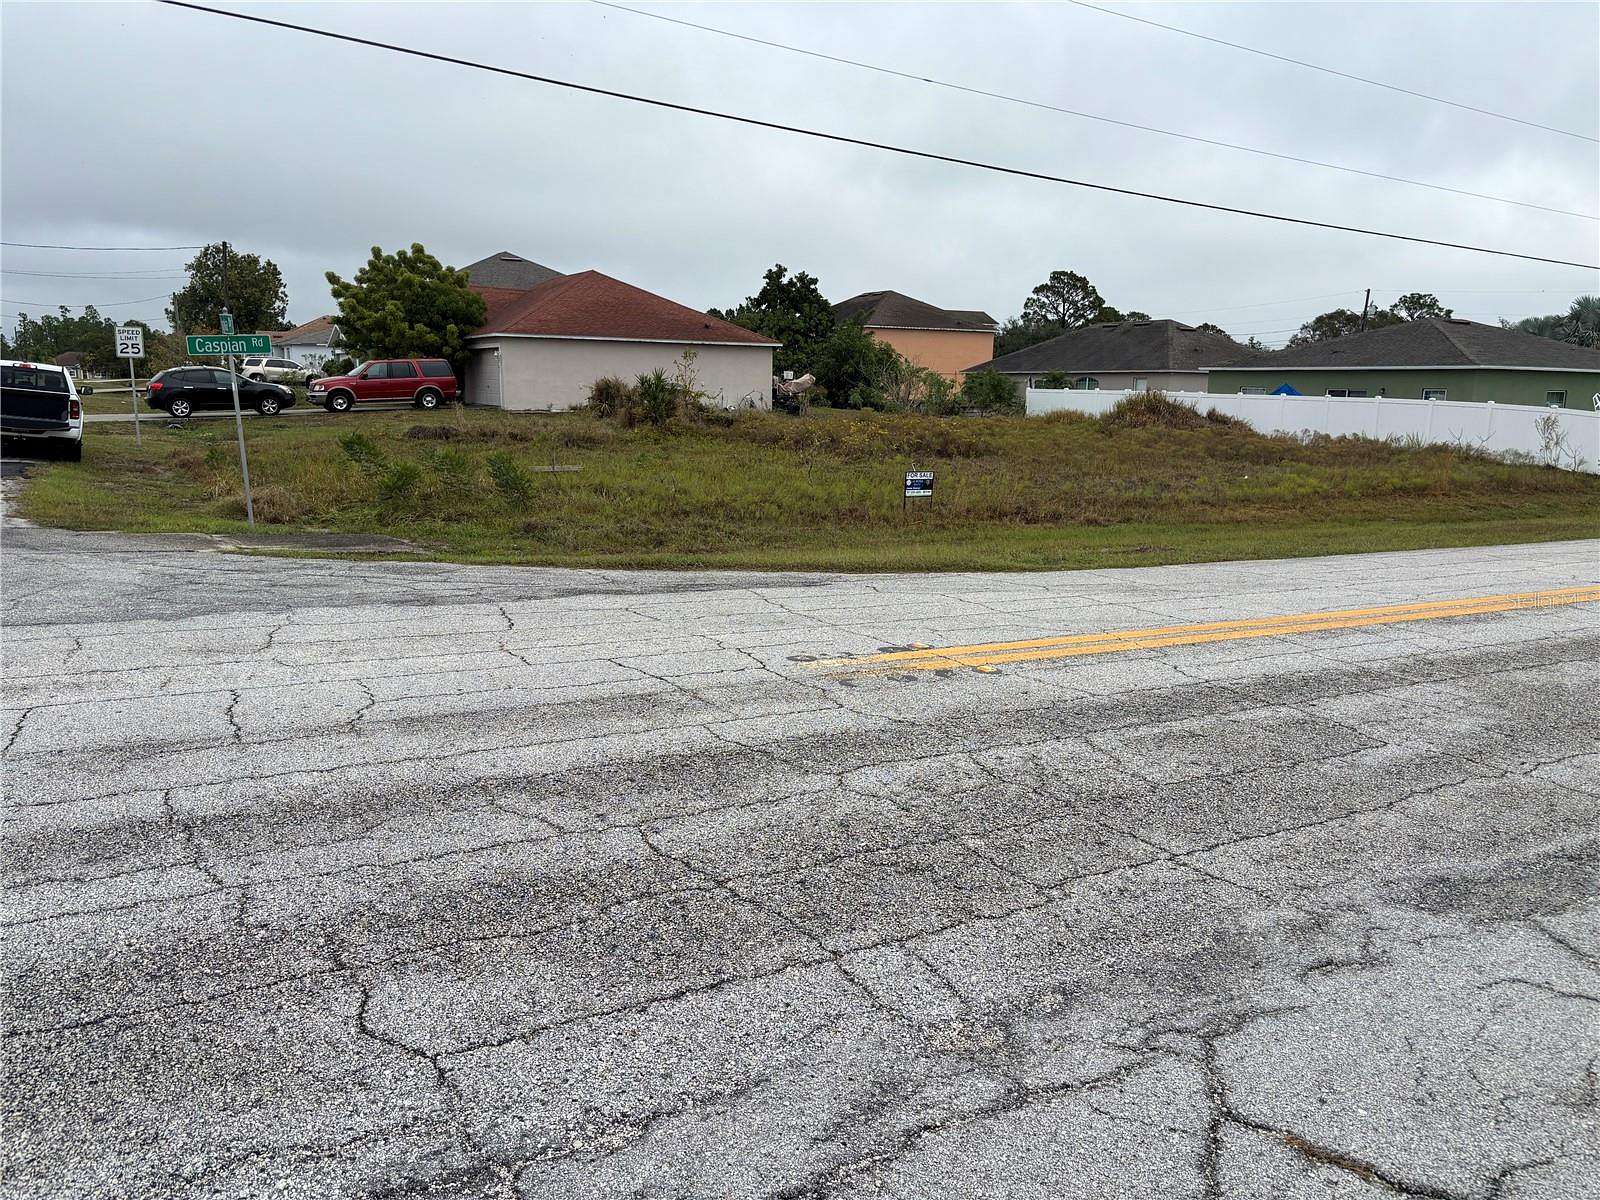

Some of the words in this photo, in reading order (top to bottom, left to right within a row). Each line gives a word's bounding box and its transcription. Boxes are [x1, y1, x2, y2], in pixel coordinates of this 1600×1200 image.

[119, 342, 141, 355] 25
[195, 338, 247, 355] Caspian
[251, 337, 264, 348] Rd
